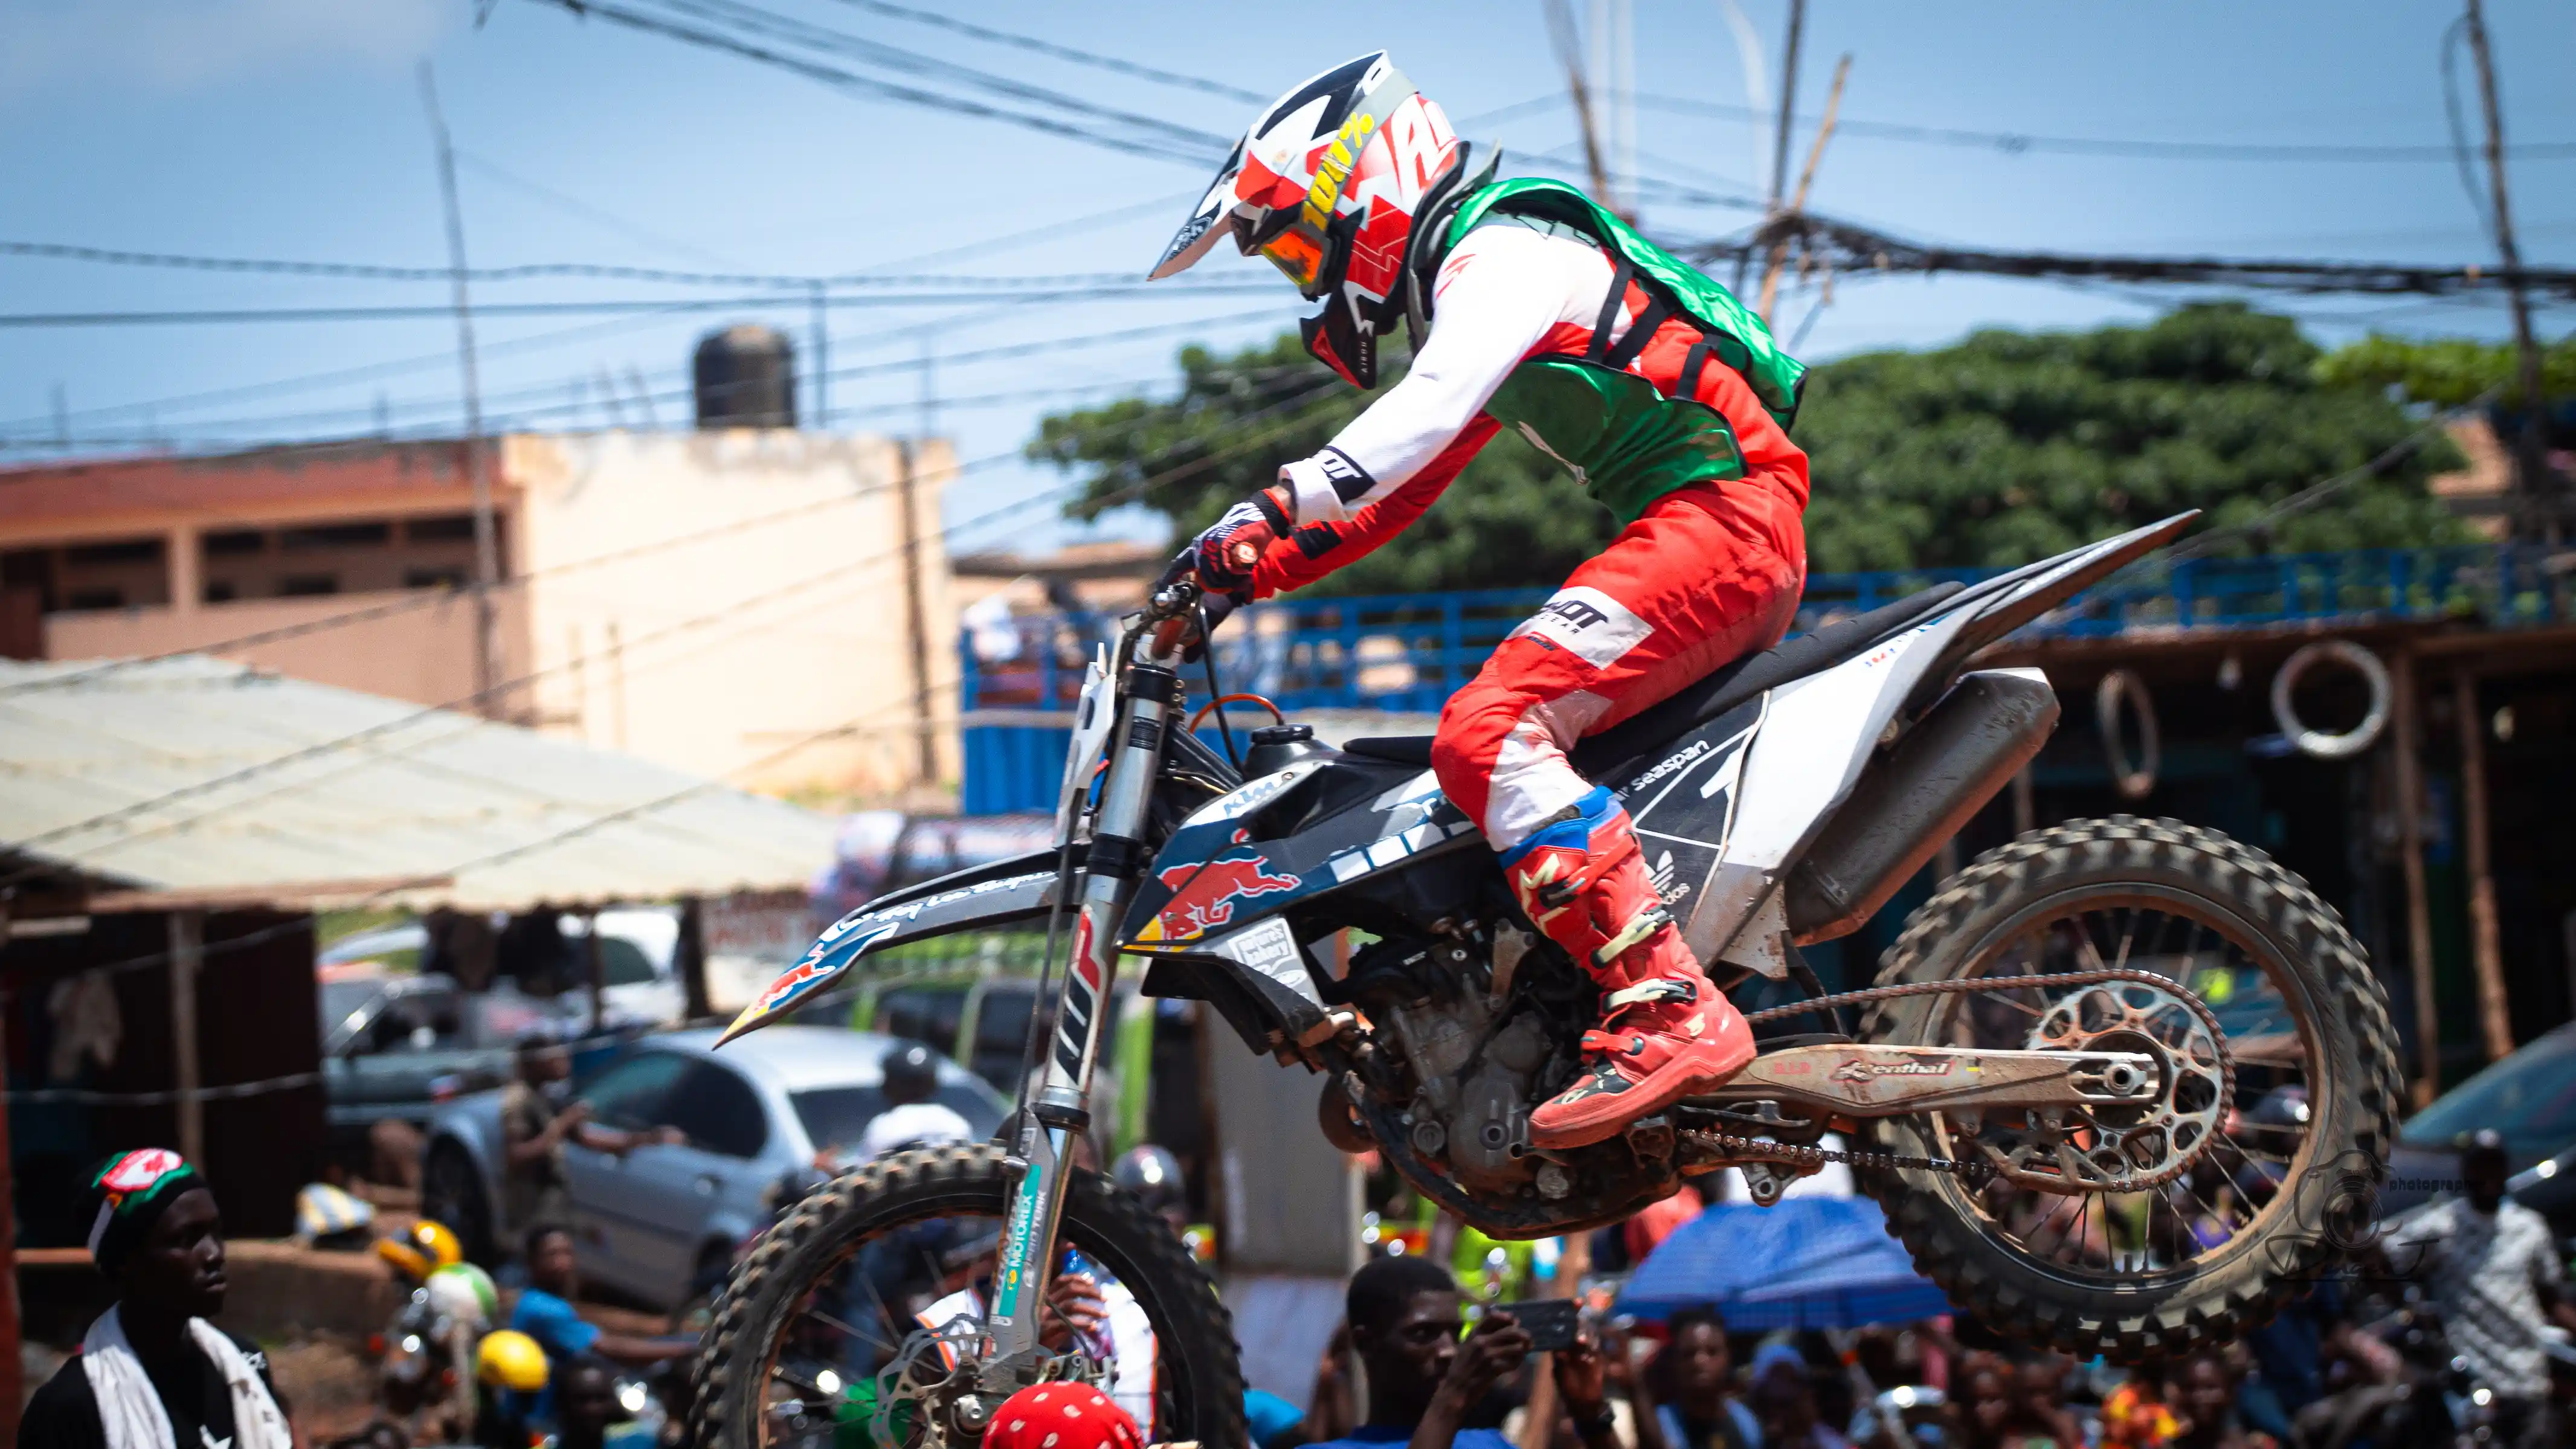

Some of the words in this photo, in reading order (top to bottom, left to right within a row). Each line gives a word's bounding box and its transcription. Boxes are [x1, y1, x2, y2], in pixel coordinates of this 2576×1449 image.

[1302, 111, 1375, 232] 100%
[1631, 739, 1710, 792] seaspan
[1008, 1194, 1033, 1267] MOTOREX
